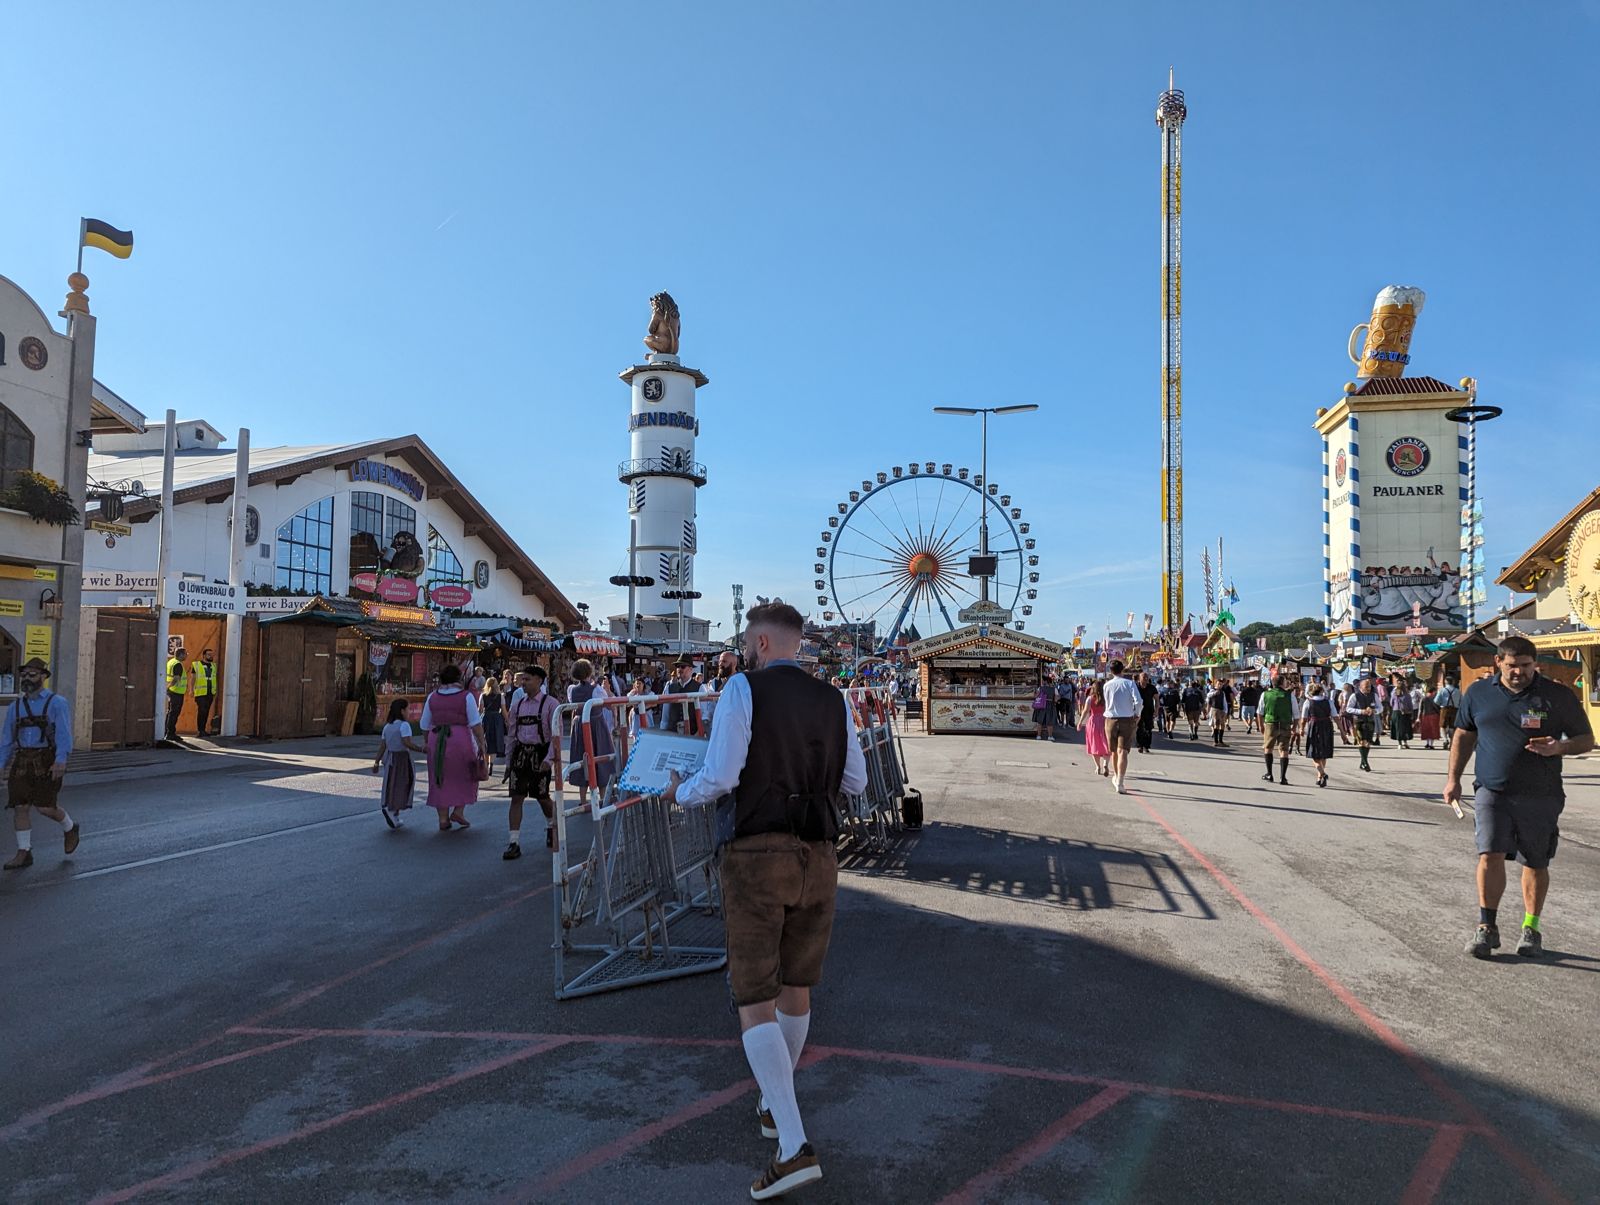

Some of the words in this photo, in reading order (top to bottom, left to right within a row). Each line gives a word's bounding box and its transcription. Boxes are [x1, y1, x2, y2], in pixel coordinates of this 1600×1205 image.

[1388, 438, 1428, 454] PAULANER
[1391, 465, 1425, 476] MÜNCHEN
[351, 460, 424, 501] LÖWENBRÄU
[1373, 484, 1445, 497] PAULANER
[90, 573, 111, 586] wie
[115, 573, 158, 590] Bayern
[187, 582, 227, 597] LÖWENBRÄU
[178, 594, 235, 612] Biergarten
[259, 598, 277, 609] wie
[964, 628, 978, 637] Welt
[956, 649, 1011, 657] Mandelbrennerei
[1044, 644, 1058, 654] Welt
